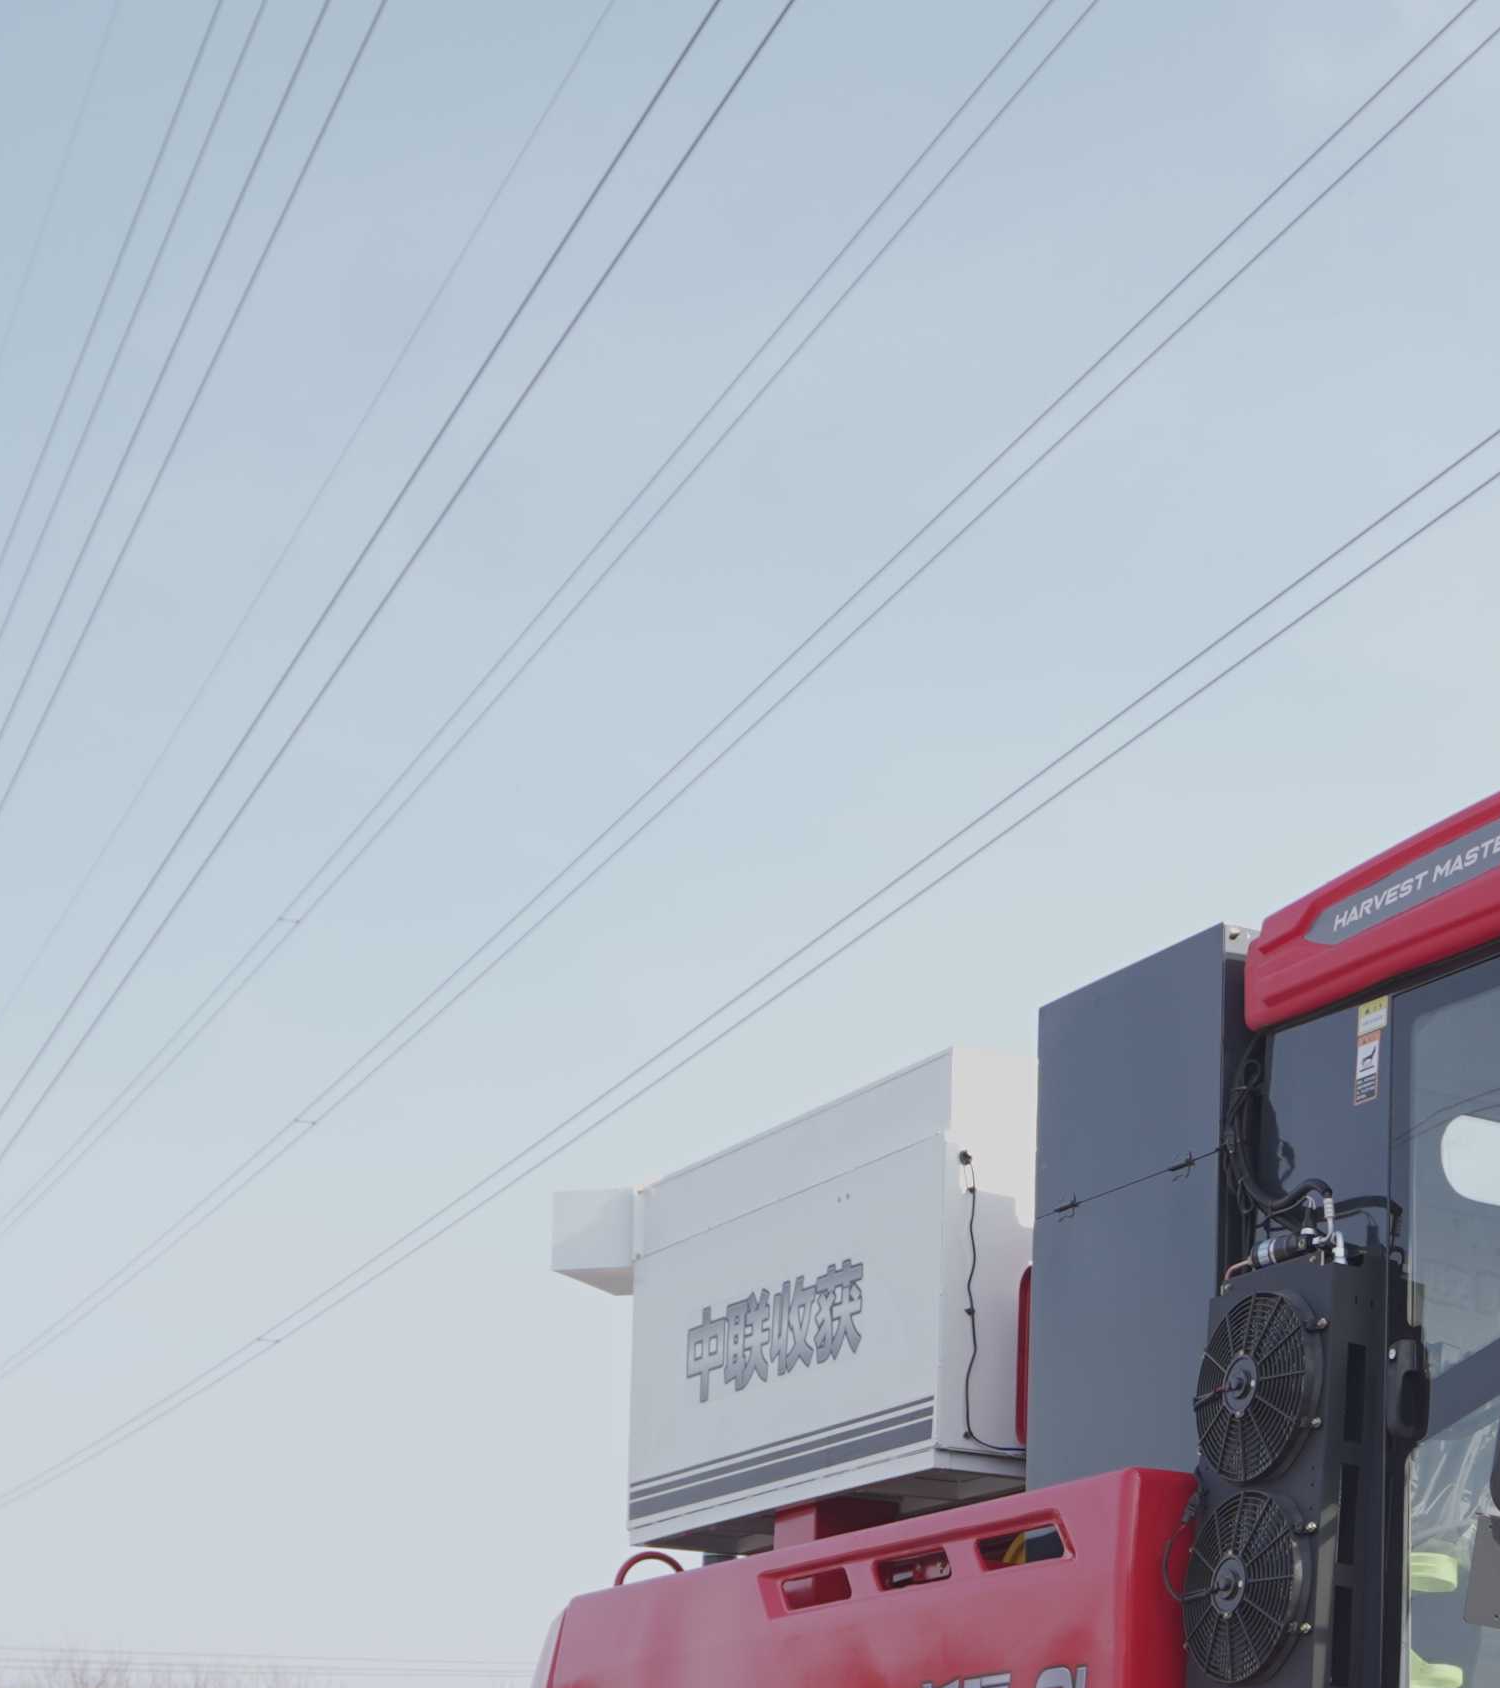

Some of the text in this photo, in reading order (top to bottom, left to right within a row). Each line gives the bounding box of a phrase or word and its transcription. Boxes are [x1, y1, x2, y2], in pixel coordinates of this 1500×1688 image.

[1333, 870, 1427, 931] HARVEST
[686, 1258, 864, 1403] 中联收获
